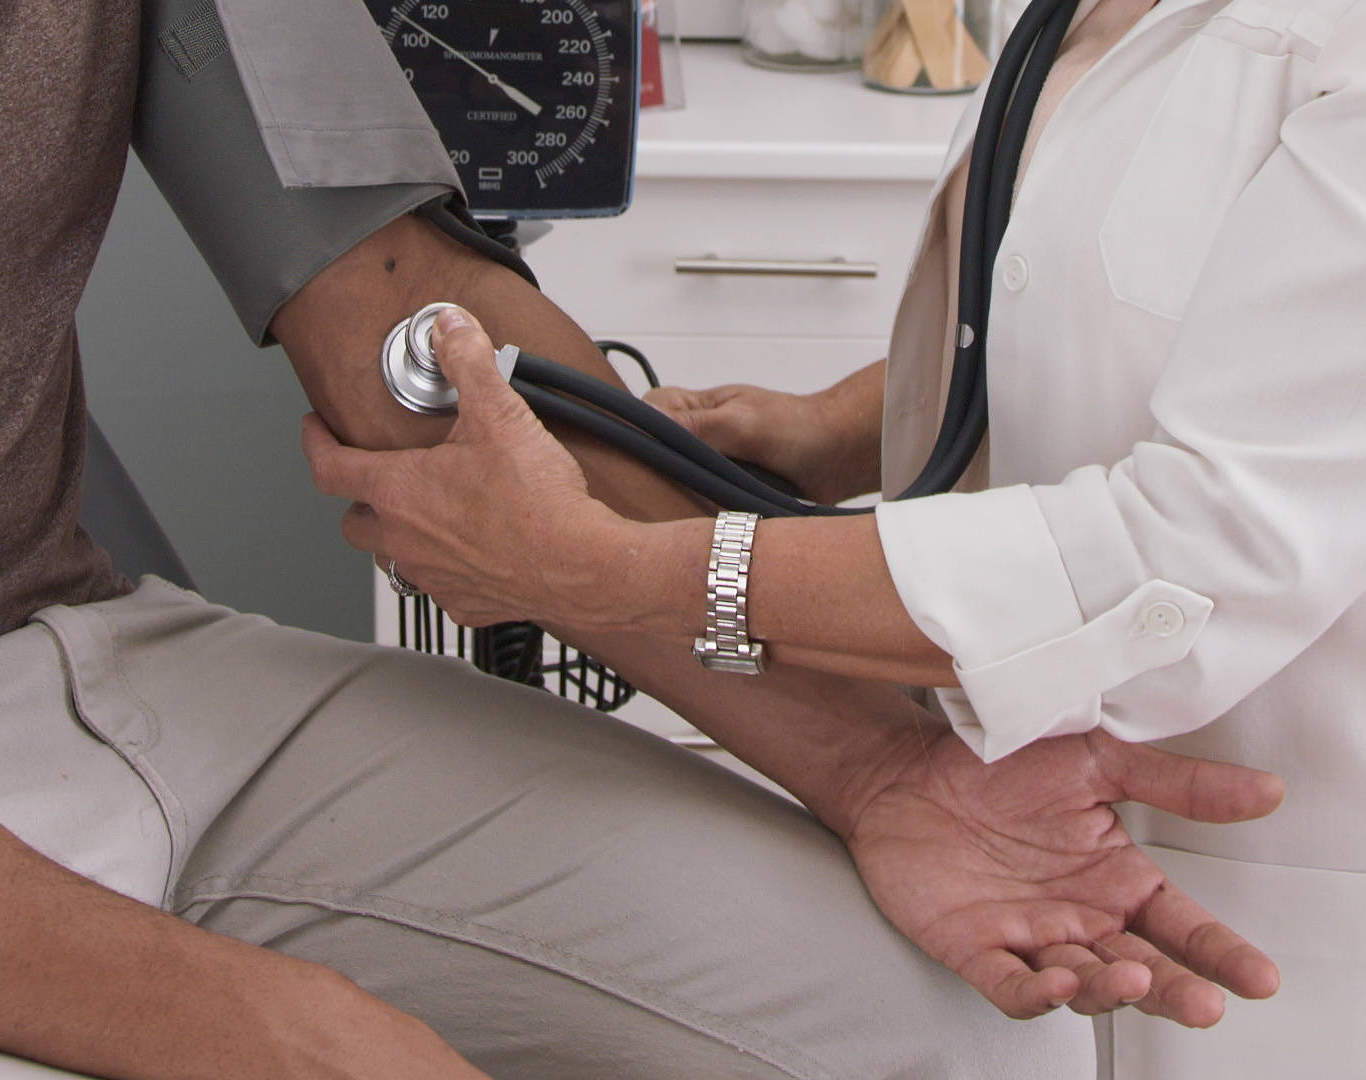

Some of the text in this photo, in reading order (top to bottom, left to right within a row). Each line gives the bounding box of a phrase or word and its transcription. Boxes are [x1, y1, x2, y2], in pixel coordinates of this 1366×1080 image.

[421, 5, 448, 19] 120
[541, 10, 573, 24] 200
[401, 33, 429, 48] 100
[558, 40, 591, 54] 220
[562, 72, 594, 86] 240
[466, 111, 517, 121] CERTIFIED
[556, 105, 586, 119] 260
[535, 132, 566, 147] 280
[449, 150, 470, 164] 20
[506, 150, 539, 165] 300
